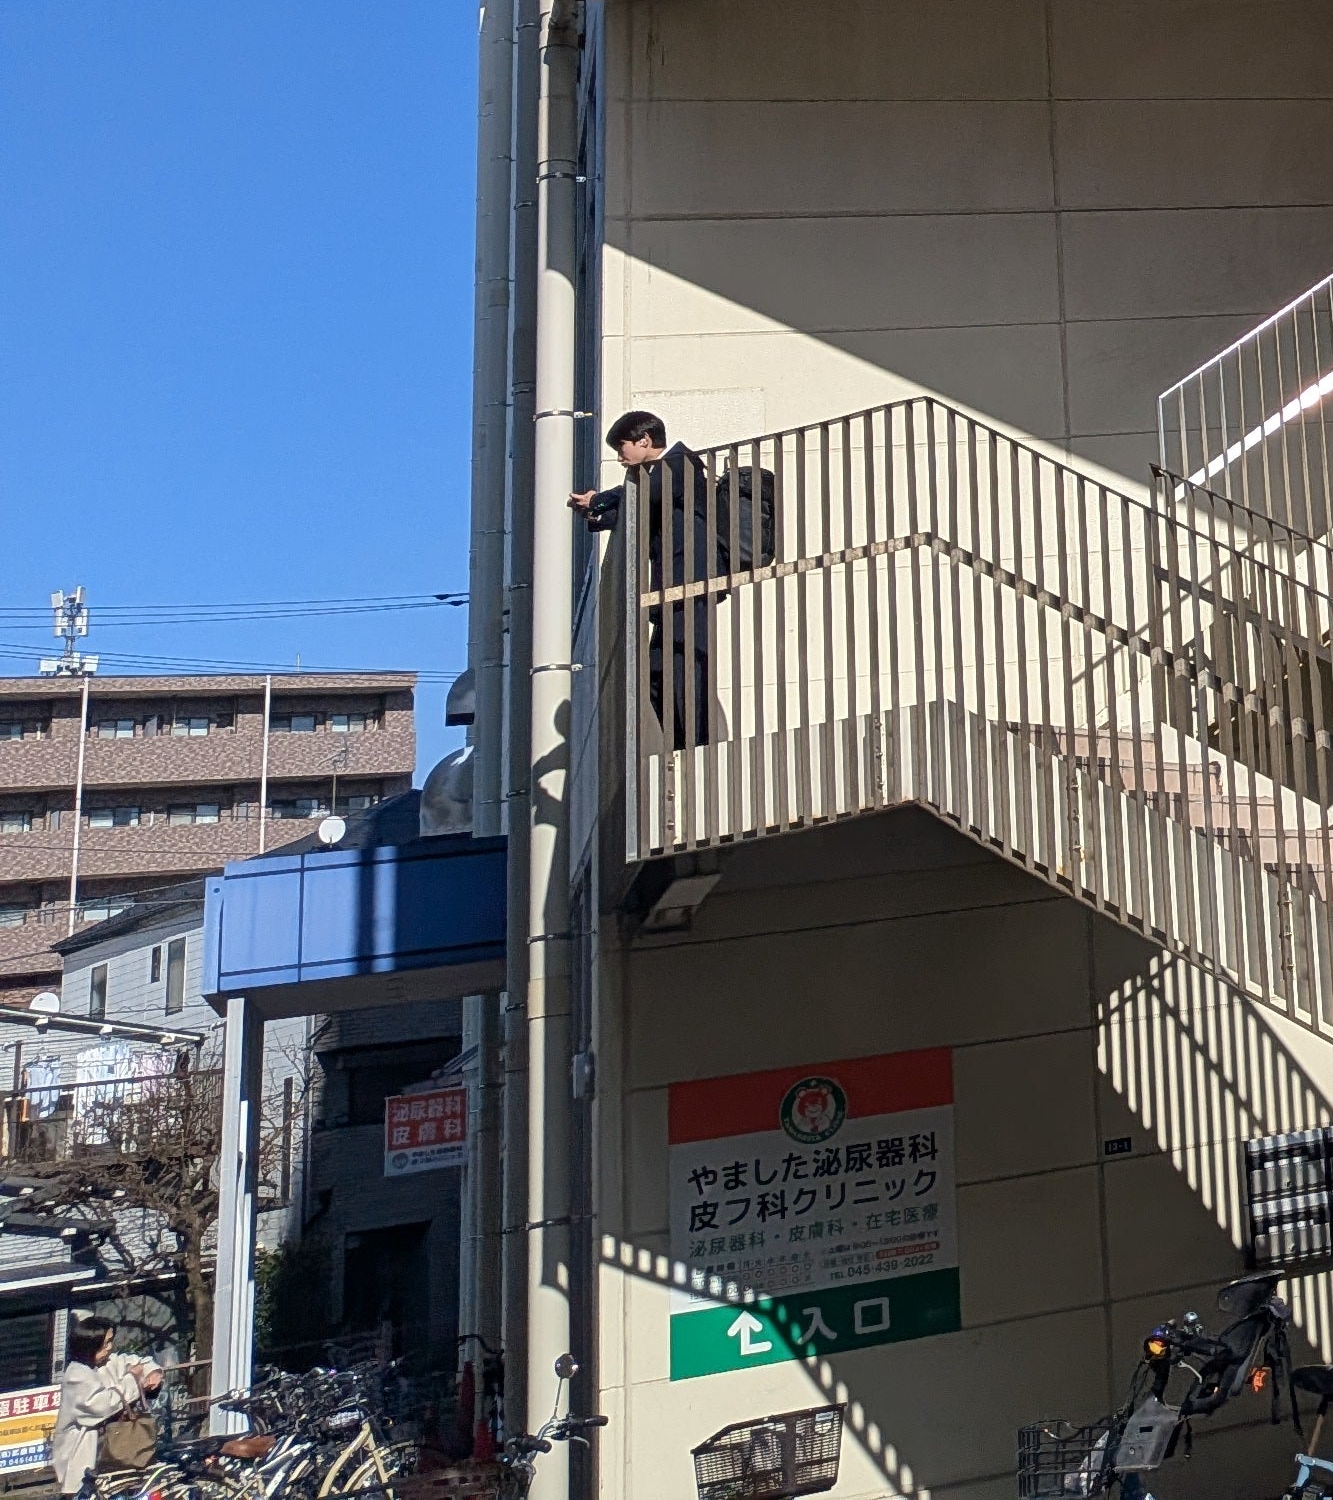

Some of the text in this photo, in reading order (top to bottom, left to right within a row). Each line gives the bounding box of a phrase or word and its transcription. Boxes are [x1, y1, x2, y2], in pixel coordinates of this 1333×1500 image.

[688, 1131, 939, 1196] やました泌尿器科
[688, 1169, 937, 1233] 皮フ科クリニック
[801, 1296, 891, 1342] 入口
